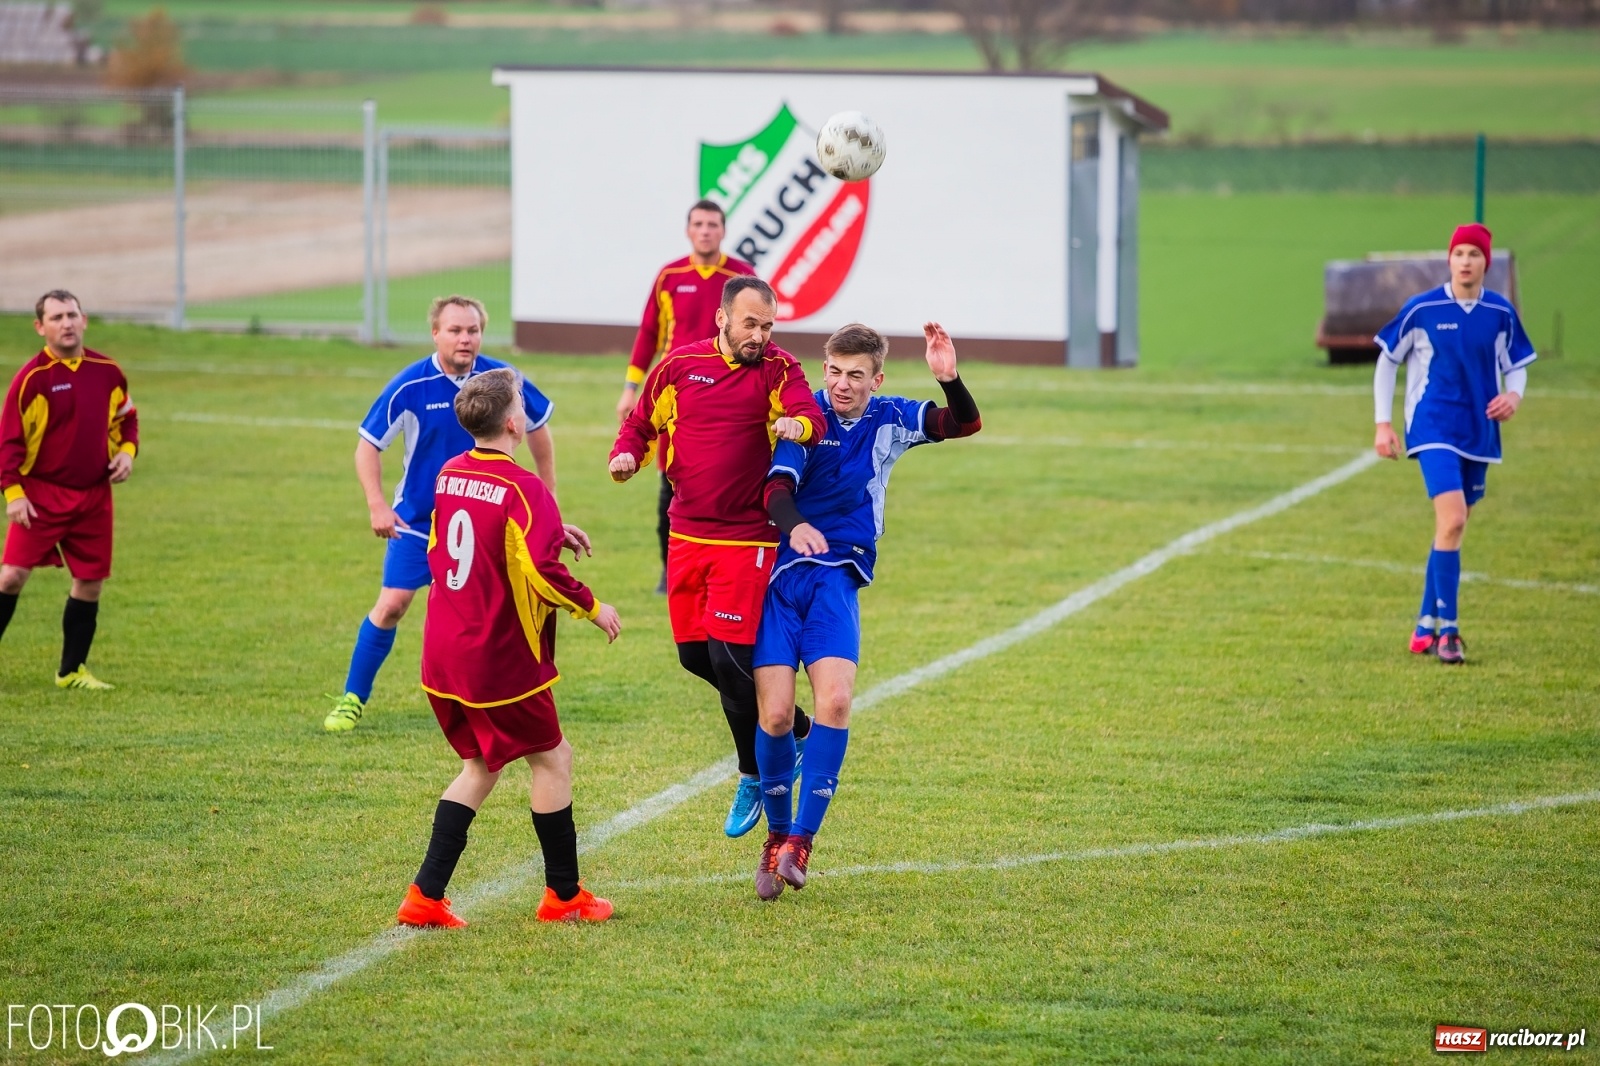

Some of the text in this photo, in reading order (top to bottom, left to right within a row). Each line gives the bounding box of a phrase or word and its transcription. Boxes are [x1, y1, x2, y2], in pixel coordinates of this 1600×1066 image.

[735, 158, 827, 267] RUCH
[446, 476, 468, 496] RUCH
[464, 479, 508, 505] BOLESŁAW
[446, 509, 475, 591] 9
